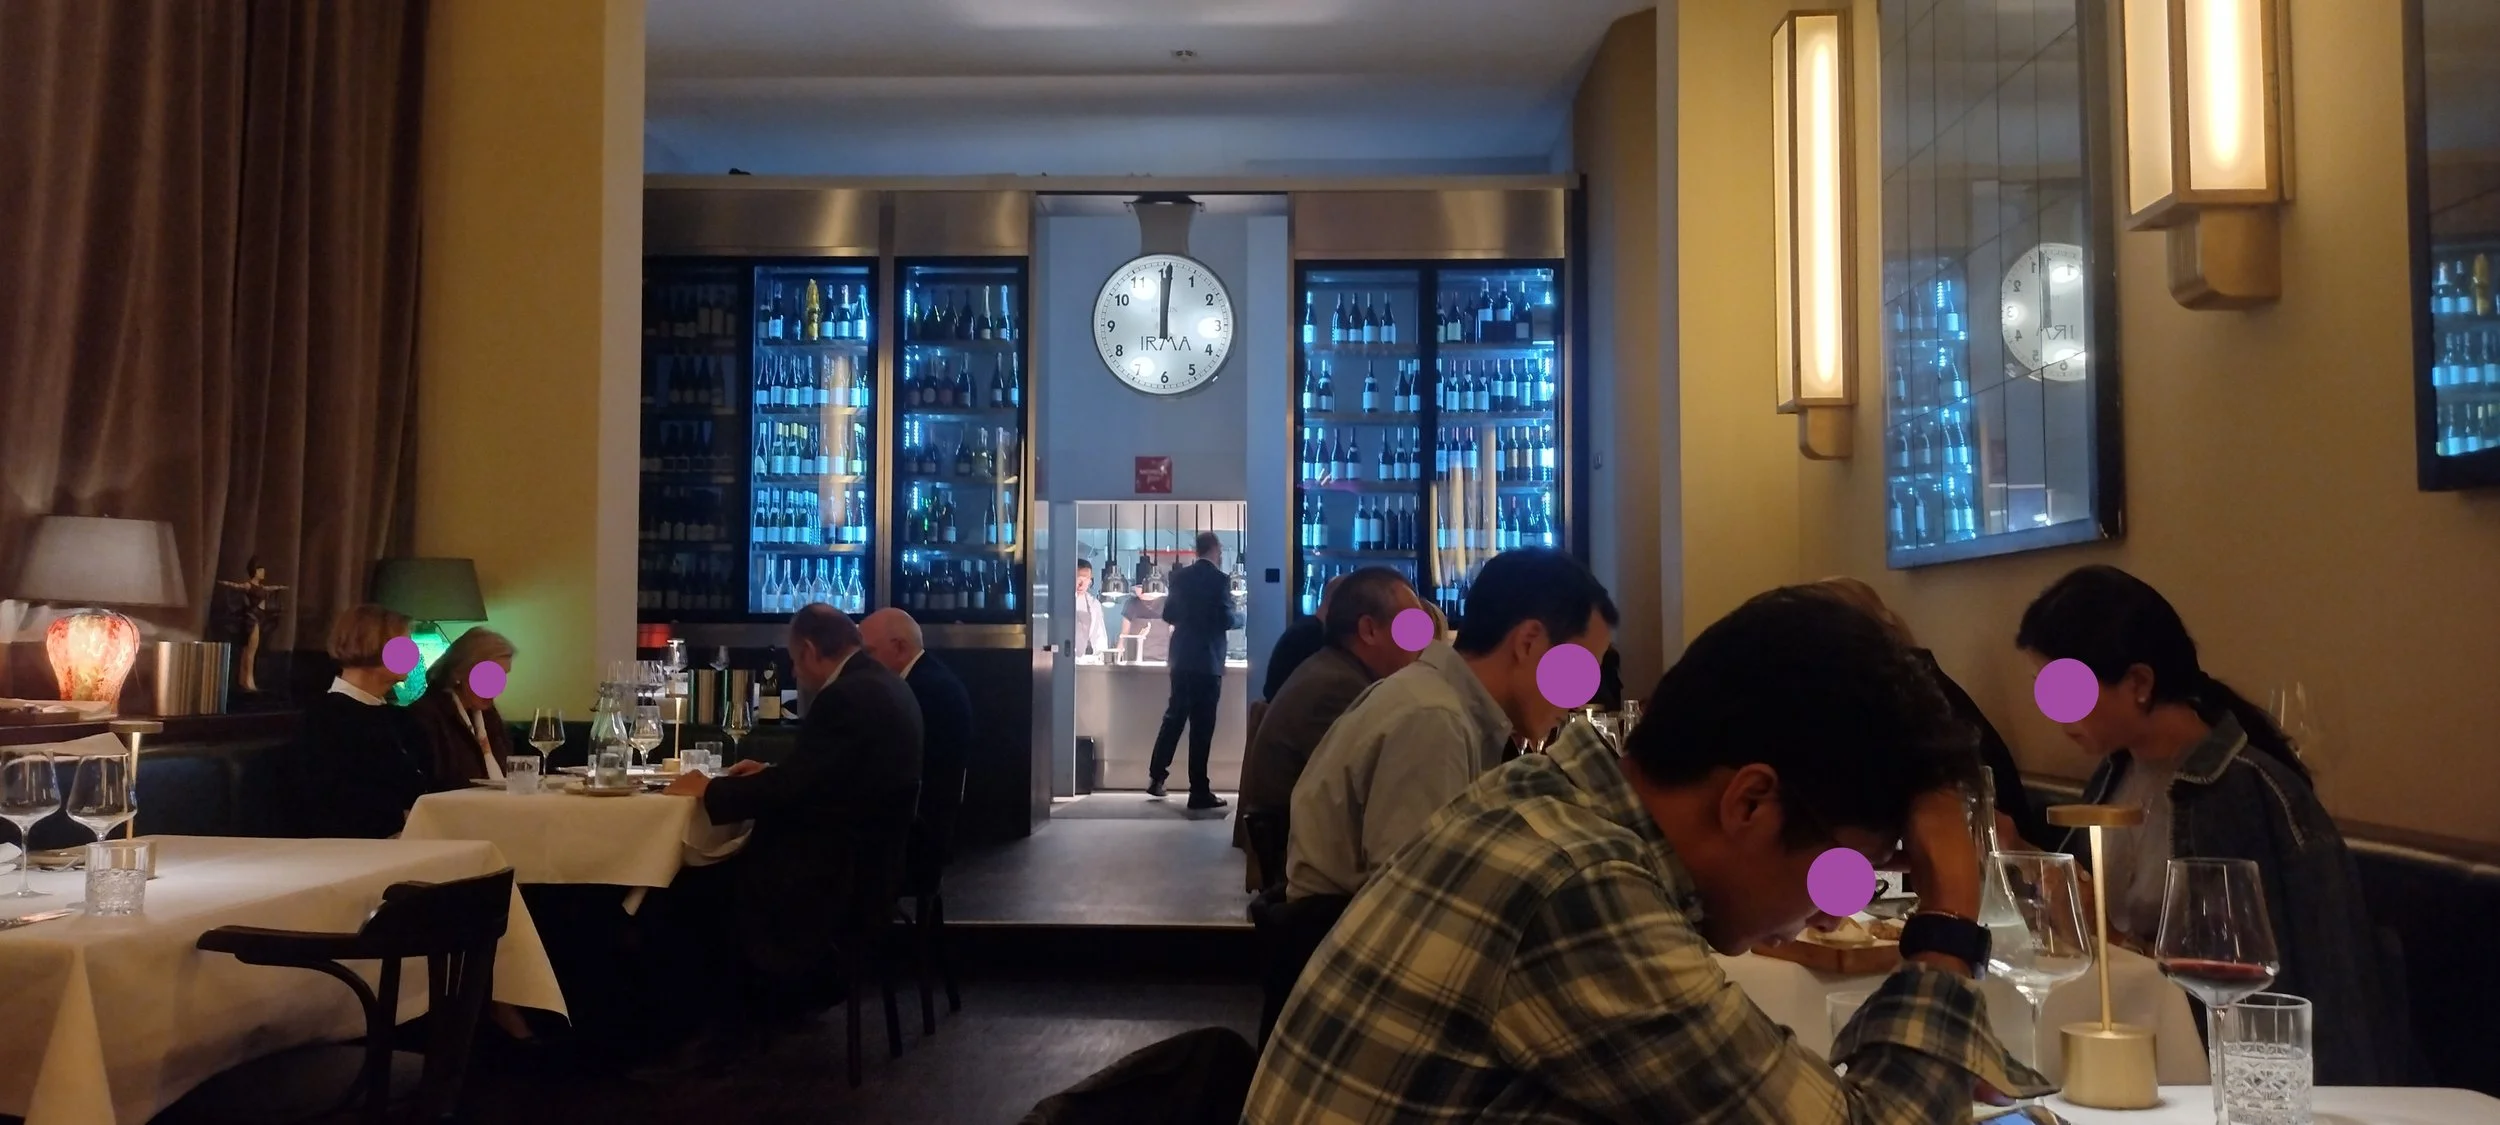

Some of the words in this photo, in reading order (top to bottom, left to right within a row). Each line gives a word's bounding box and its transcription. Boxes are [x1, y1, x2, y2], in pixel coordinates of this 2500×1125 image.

[1130, 276, 1145, 289] 11
[1188, 275, 1195, 288] 1
[1114, 293, 1130, 307] 10
[1205, 293, 1214, 306] 2
[1107, 320, 1116, 333] 9
[1214, 319, 1222, 332] 3
[1140, 336, 1191, 351] IRMA
[1204, 344, 1213, 356] 4
[1115, 344, 1123, 357] 8
[1134, 363, 1141, 376] 7
[1188, 363, 1196, 376] 5
[1160, 371, 1169, 384] 6
